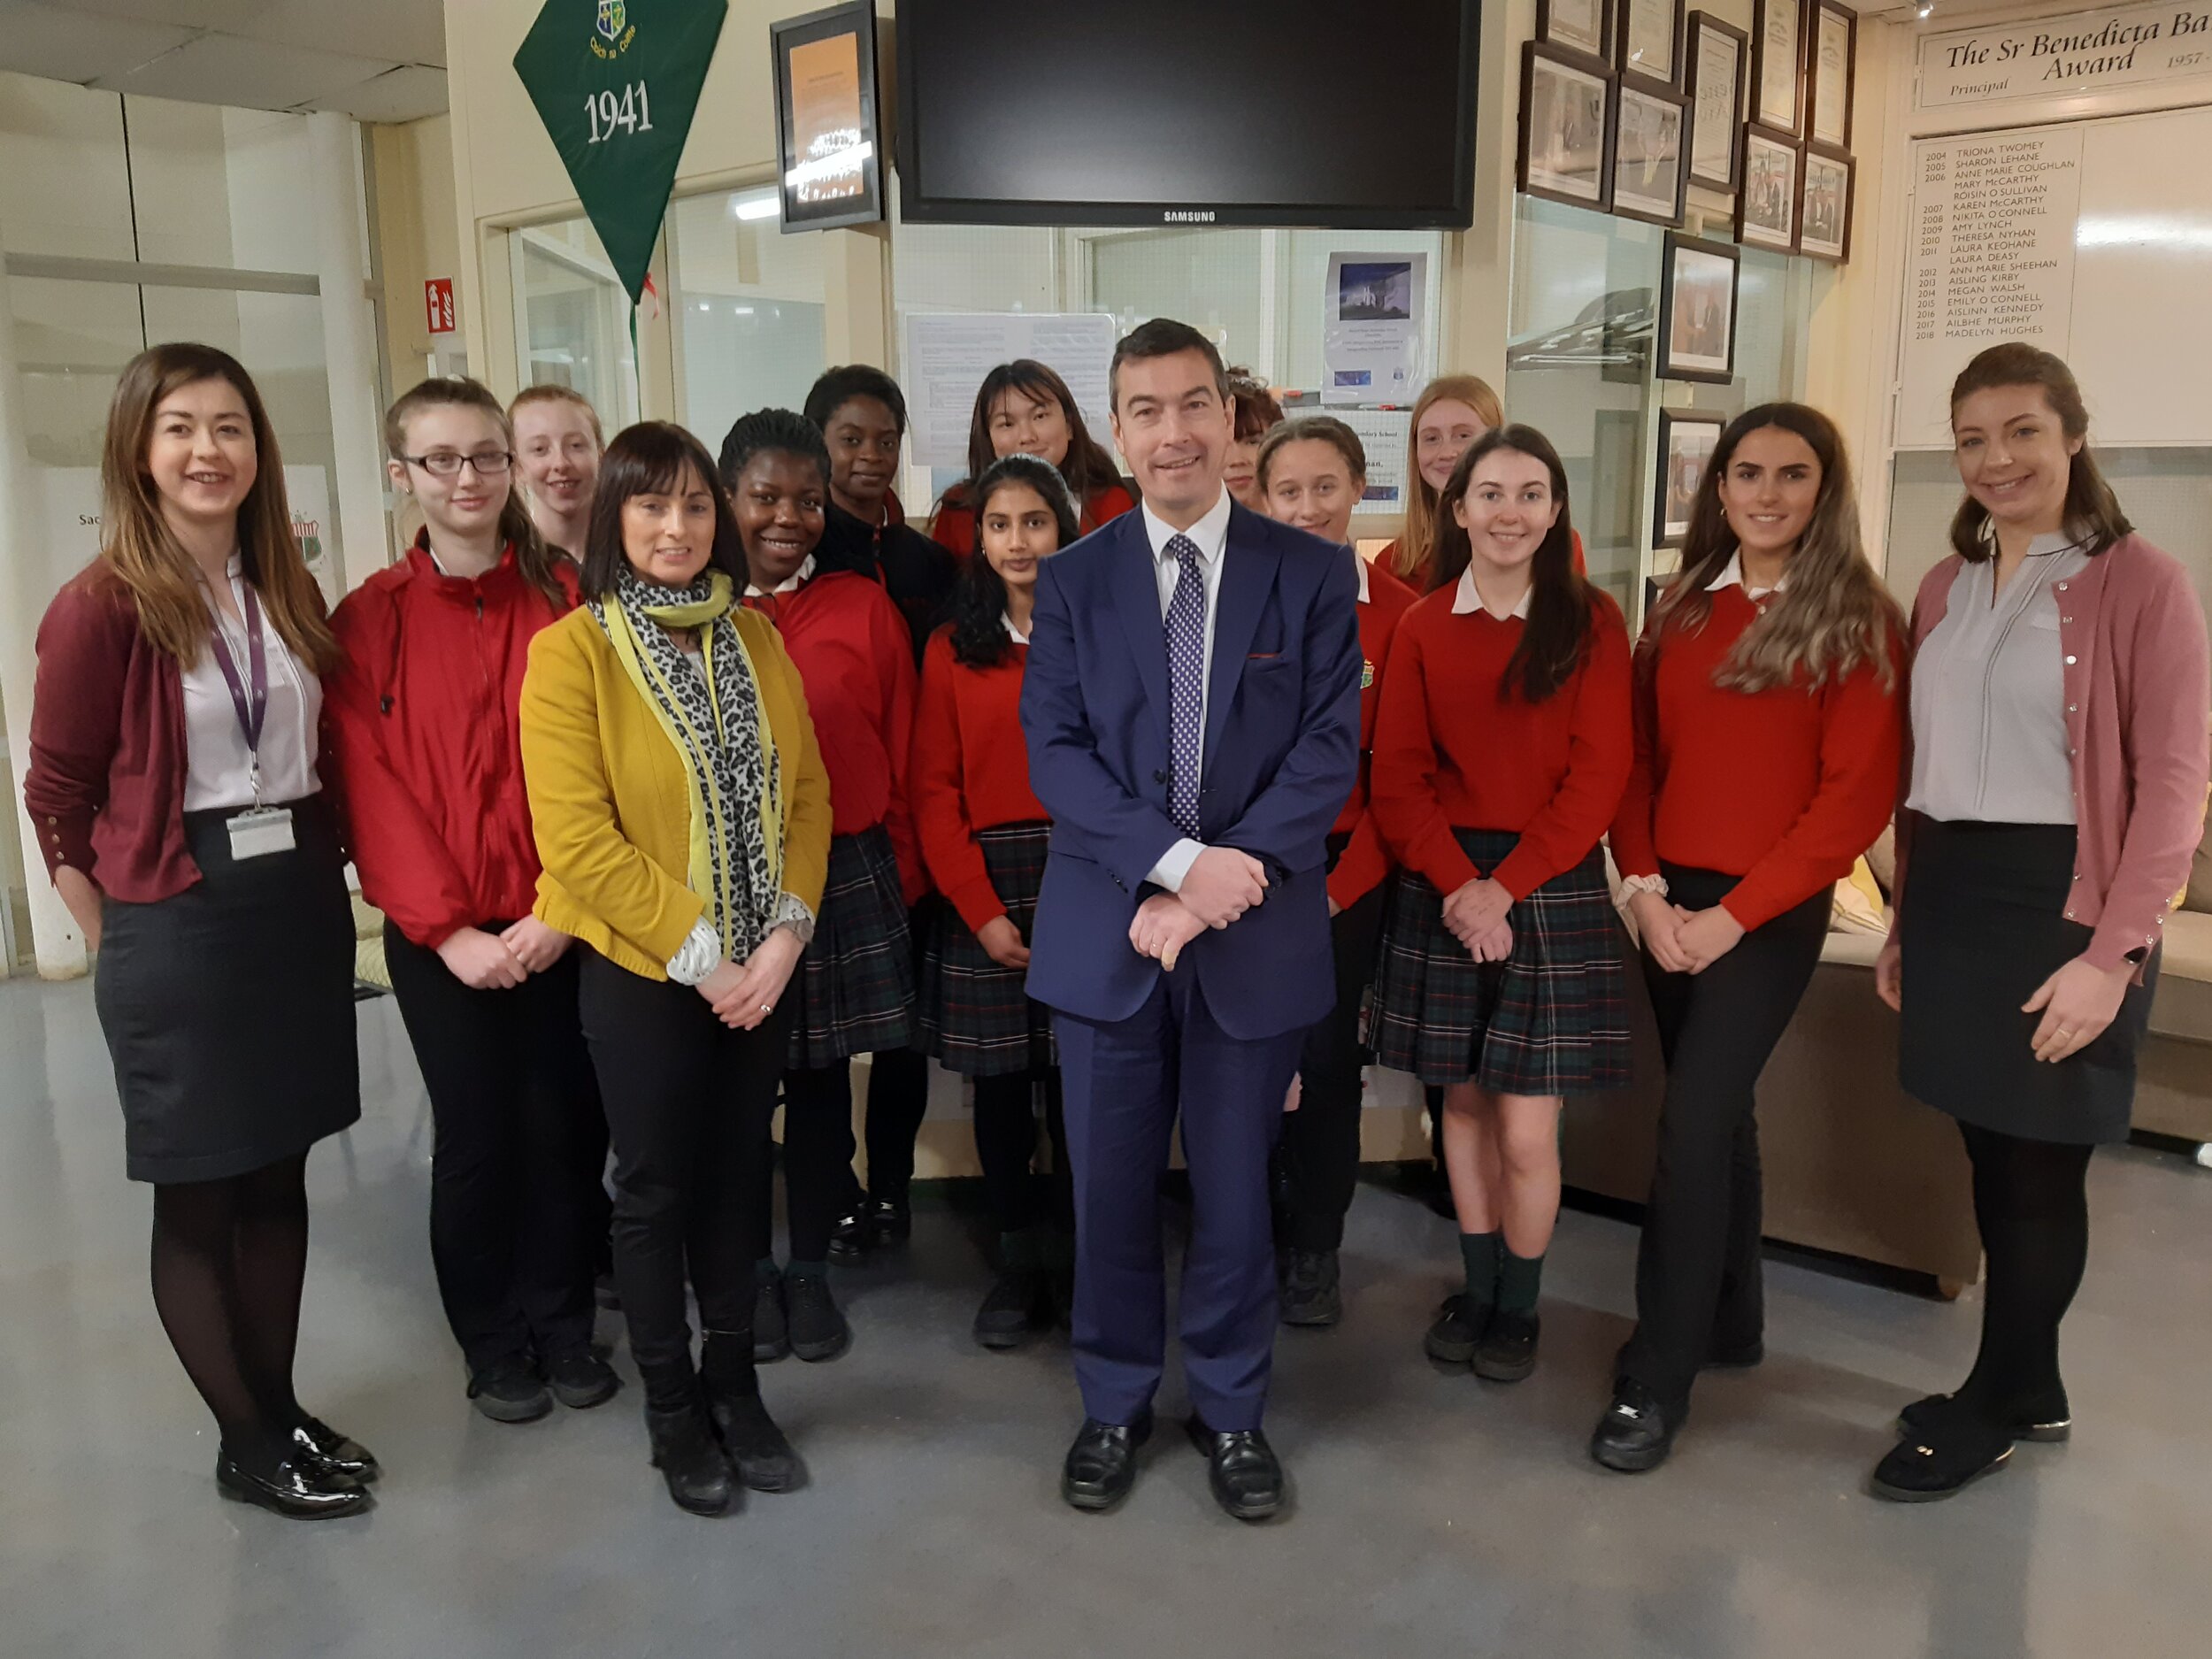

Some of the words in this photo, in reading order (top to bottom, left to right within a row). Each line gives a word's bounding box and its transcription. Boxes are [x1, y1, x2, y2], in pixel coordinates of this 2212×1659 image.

[1947, 40, 1990, 68] The
[1997, 39, 2024, 62] Sr
[2030, 19, 2160, 58] Benedicta
[2167, 12, 2212, 38] Ba
[2042, 40, 2146, 81] Award
[1951, 78, 2008, 97] Principal
[584, 80, 653, 143] 1941
[1926, 152, 1947, 162] 2004
[1957, 147, 1994, 158] TRIONA
[1999, 142, 2045, 153] TWOMEY
[1925, 163, 1946, 173] 2005
[1955, 157, 1996, 169] SHARON
[2001, 152, 2039, 164] LEHANE
[1925, 174, 1946, 183] 2006
[1955, 169, 1982, 180] ANNE
[1985, 166, 2014, 177] MARIE
[2017, 160, 2075, 173] COUGHLAN
[1955, 180, 1981, 189] MARY
[1985, 175, 2039, 187] McCARTHY
[1923, 205, 1944, 214] 2007
[1953, 200, 1986, 211] KAREN
[1990, 196, 2045, 208] McCARTHY
[1164, 211, 1216, 222] SAMSUNG
[1953, 210, 1985, 221] NIKITA
[1922, 226, 1943, 234] 2009
[1952, 223, 1973, 232] AMY
[1978, 220, 2012, 230] LYNCH
[1952, 232, 1994, 242] THERESA
[1999, 229, 2036, 239] NYHAN
[1920, 248, 1938, 257] 2011
[1950, 243, 1983, 254] LAURA
[1987, 239, 2037, 250] KEOHANE
[1950, 254, 1983, 265] LAURA
[1988, 252, 2020, 262] DEASY
[1919, 268, 1938, 277] 2012
[1949, 266, 1972, 275] ANN
[1976, 264, 2007, 273] MARIE
[2010, 260, 2058, 271] SHEEHAN
[1918, 279, 1936, 288] 2013
[1948, 275, 1987, 285] AISLING
[1992, 273, 2020, 282] KIRBY
[1918, 289, 1936, 298] 2014
[1947, 286, 1985, 296] MEGAN
[1991, 283, 2025, 292] WALSH
[1917, 300, 1935, 309] 2015
[1947, 296, 1977, 307] EMILY
[1916, 311, 1935, 319] 2016
[1947, 307, 1987, 318] AISLINN
[1993, 303, 2045, 314] KENNEDY
[1916, 321, 1935, 330] 2017
[1947, 318, 1982, 327] AILBHE
[1987, 314, 2032, 325] MURPHY
[1916, 331, 1934, 340] 2018
[1945, 328, 1994, 338] MADELYN
[2000, 325, 2044, 334] HUGHES
